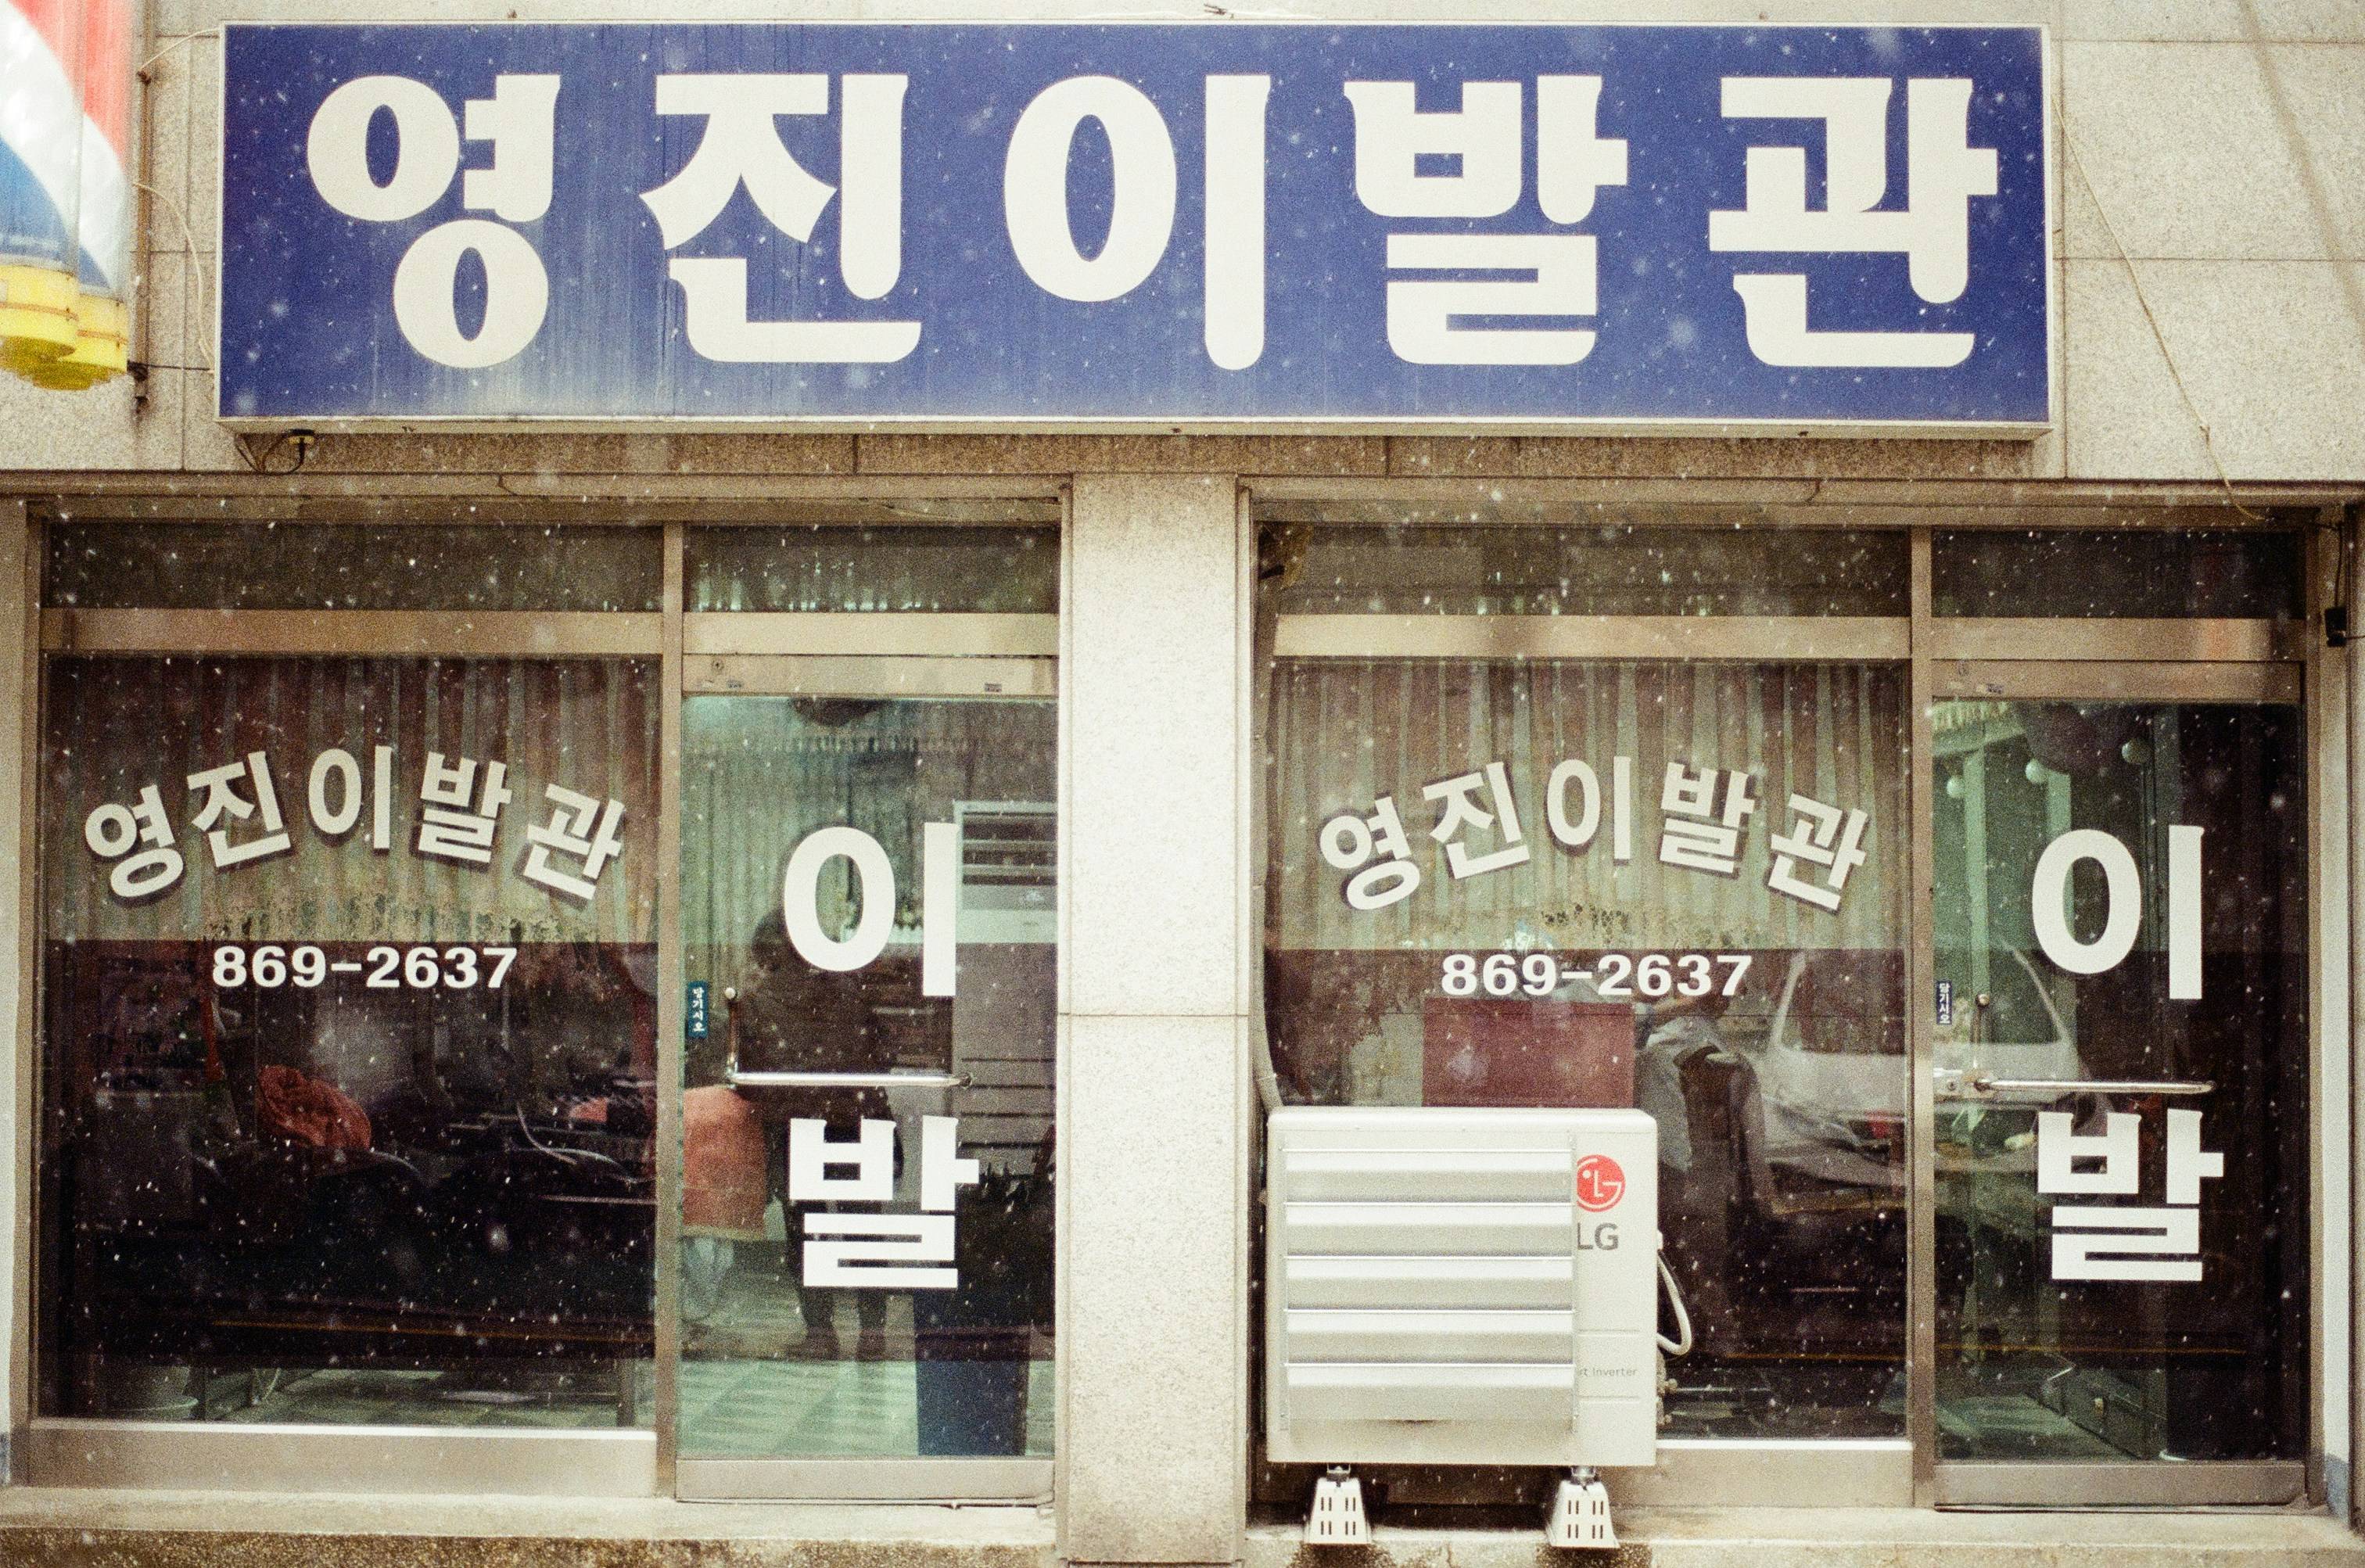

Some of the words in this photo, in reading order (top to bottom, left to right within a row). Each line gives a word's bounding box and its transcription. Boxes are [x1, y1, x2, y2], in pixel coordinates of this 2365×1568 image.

[307, 73, 1999, 371] 영진이발관
[84, 745, 625, 901] 영진이발관
[1319, 755, 1869, 912] 영진이발관
[212, 945, 518, 989] 869-2637
[1441, 953, 1752, 996] 869-2637
[691, 987, 705, 1032] 당기시오
[1577, 1222, 1619, 1250] LG
[1592, 1367, 1638, 1377] Inverter
